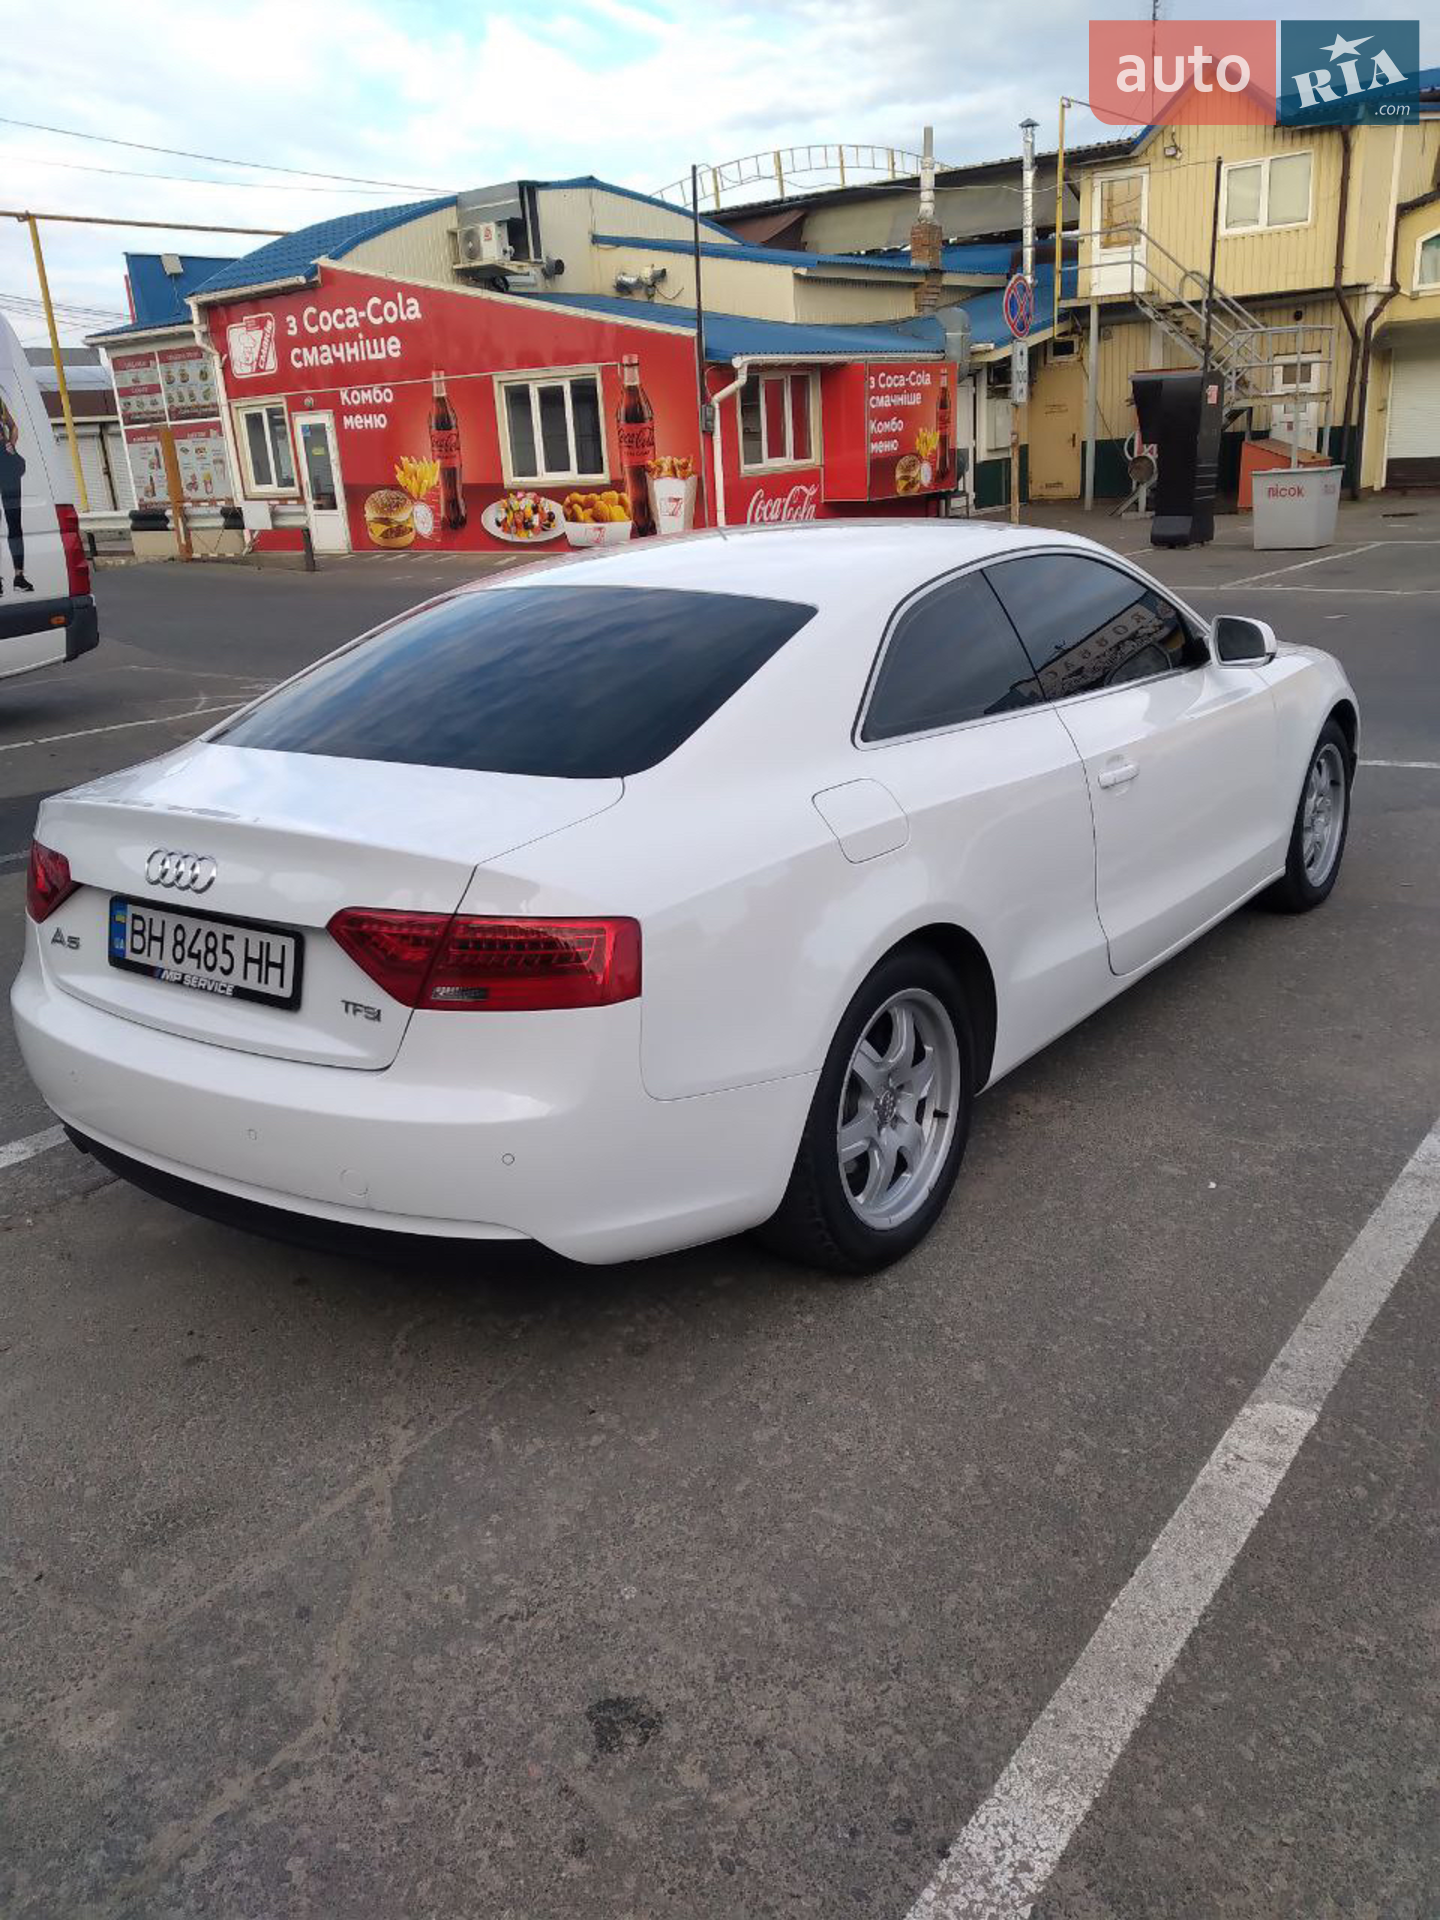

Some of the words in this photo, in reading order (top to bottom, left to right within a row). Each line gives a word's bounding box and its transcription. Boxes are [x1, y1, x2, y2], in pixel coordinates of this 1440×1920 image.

[286, 314, 298, 336] з
[302, 292, 422, 334] Coca-Cola
[290, 333, 402, 369] смачніше
[869, 375, 876, 389] з
[878, 370, 932, 389] Coca-Cola
[339, 385, 394, 406] Комбо
[869, 390, 922, 409] смачніше
[342, 413, 388, 430] меню
[869, 416, 904, 434] Комбо
[870, 439, 899, 454] меню
[746, 484, 819, 524] Coca-Cola
[51, 927, 81, 950] A5
[129, 912, 166, 961] BH
[172, 923, 235, 976] 8485
[242, 937, 286, 989] HH
[161, 968, 182, 983] MP
[183, 973, 235, 997] SERVICE
[341, 1000, 382, 1022] TFSI
